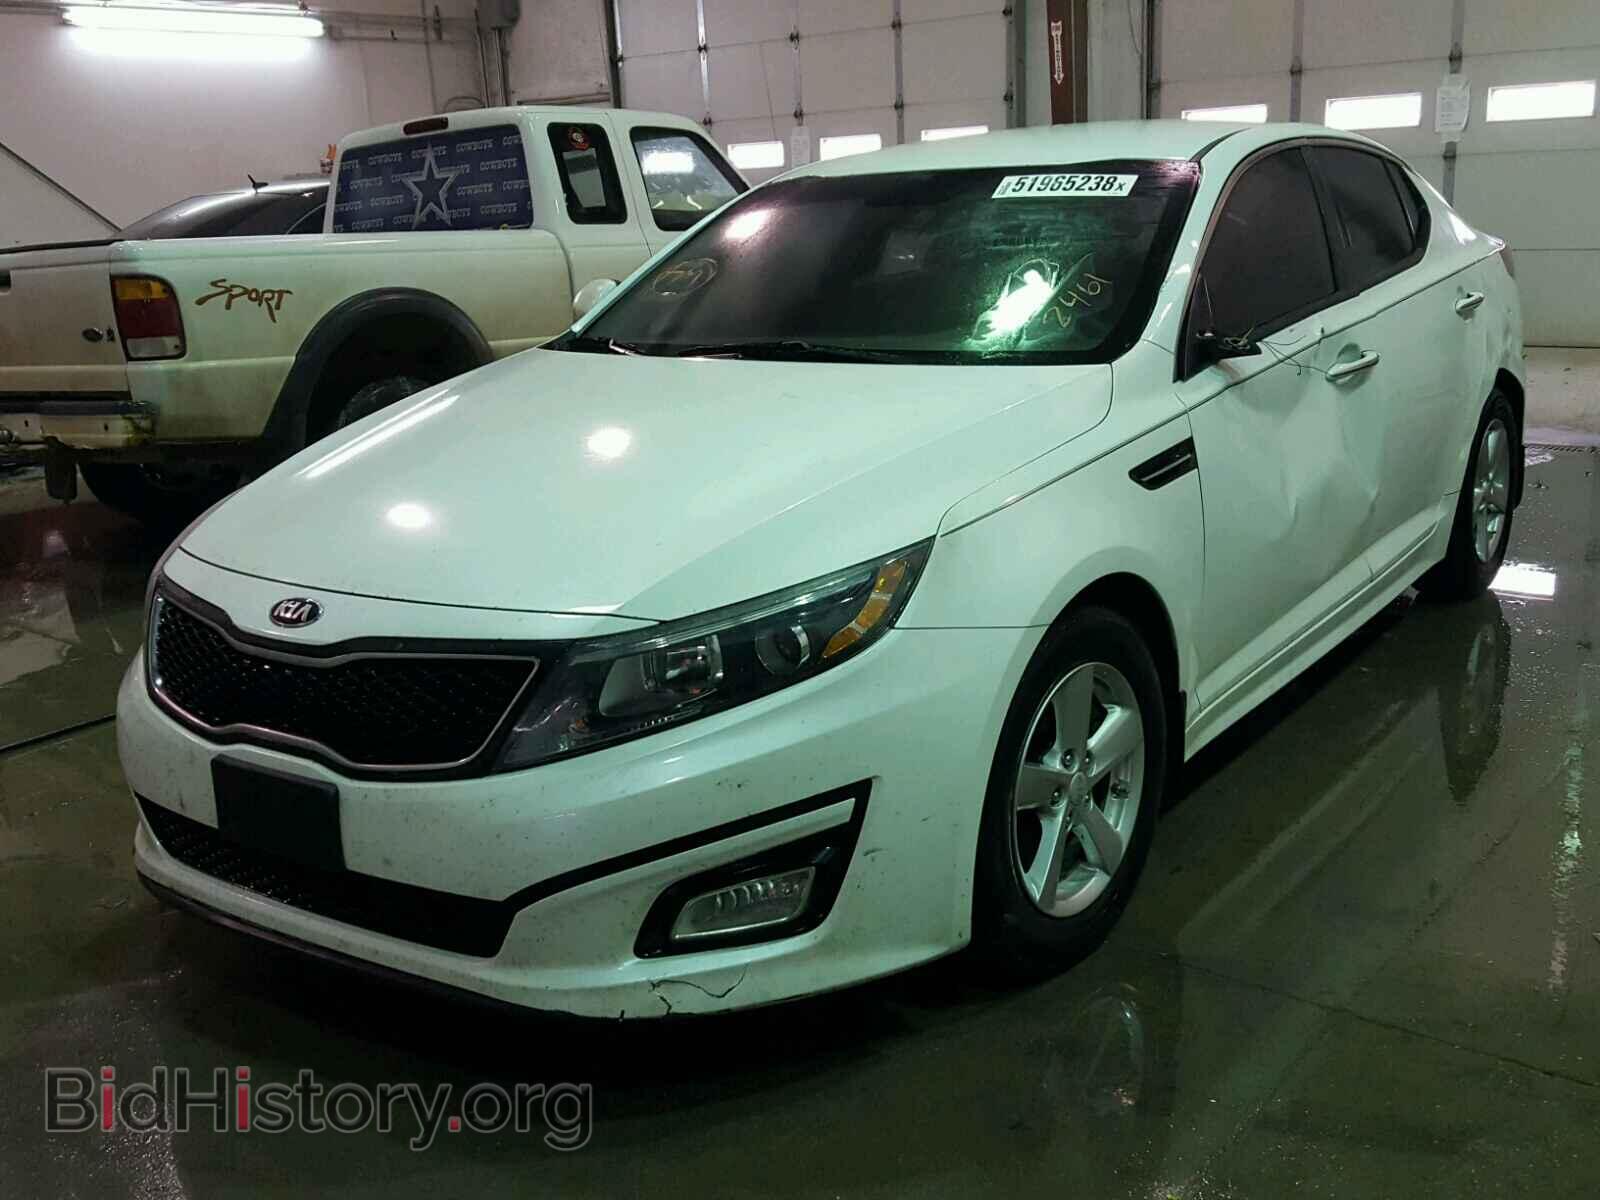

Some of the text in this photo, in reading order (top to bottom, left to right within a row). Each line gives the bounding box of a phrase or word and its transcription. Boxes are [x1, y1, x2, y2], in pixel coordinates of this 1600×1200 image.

[368, 152, 402, 166] COWBOYS
[456, 139, 494, 152] COWBOYS
[350, 176, 384, 190] COWBOYS
[479, 158, 518, 171] COWBOYS
[370, 194, 404, 208] COWBOYS
[456, 183, 495, 196] COWBOYS
[351, 217, 385, 231] COWBOYS
[480, 203, 518, 216] COWBOYS
[195, 278, 293, 323] SPORT
[1042, 273, 1113, 328] 2461
[273, 600, 313, 622] KIA
